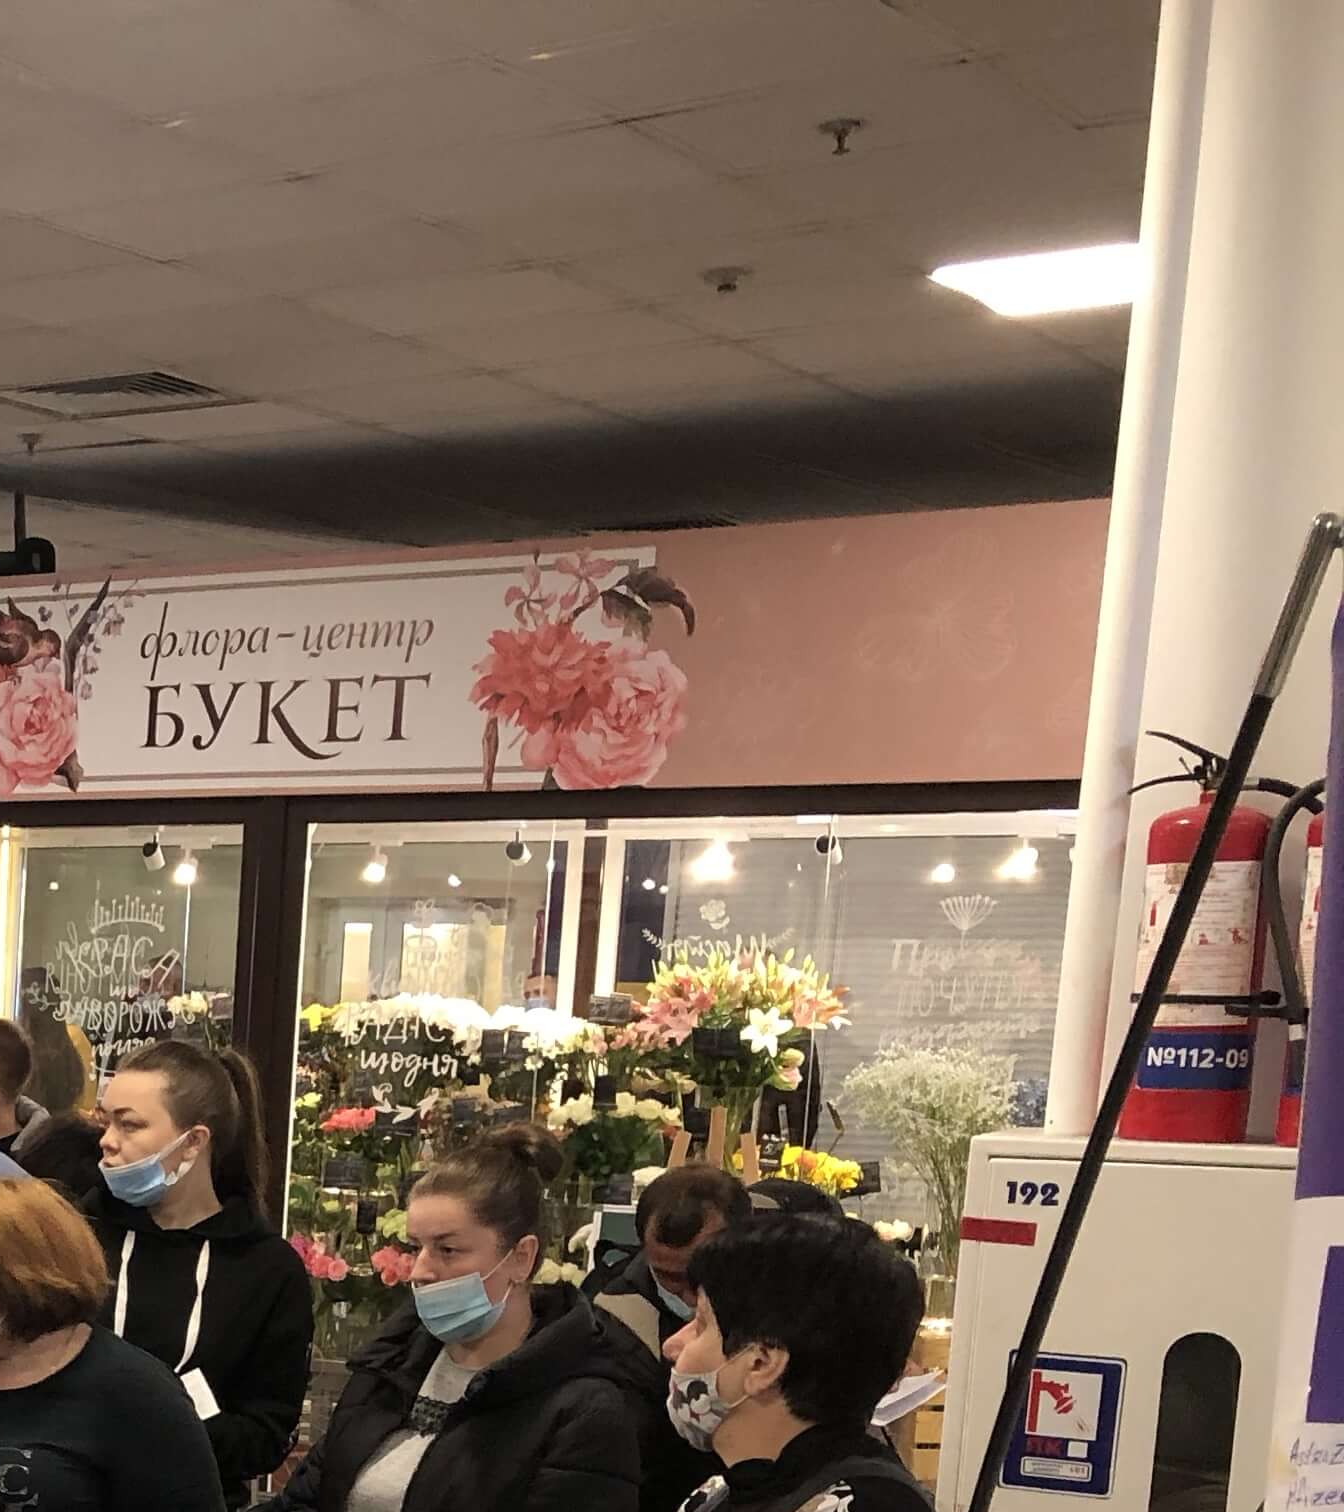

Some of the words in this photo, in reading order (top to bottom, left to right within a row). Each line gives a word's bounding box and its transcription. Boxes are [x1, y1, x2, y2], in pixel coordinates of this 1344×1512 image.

[140, 602, 434, 681] флора-центр
[139, 672, 431, 760] БУКЕТ
[1146, 1046, 1249, 1069] №112-09
[1006, 1181, 1060, 1206] 192
